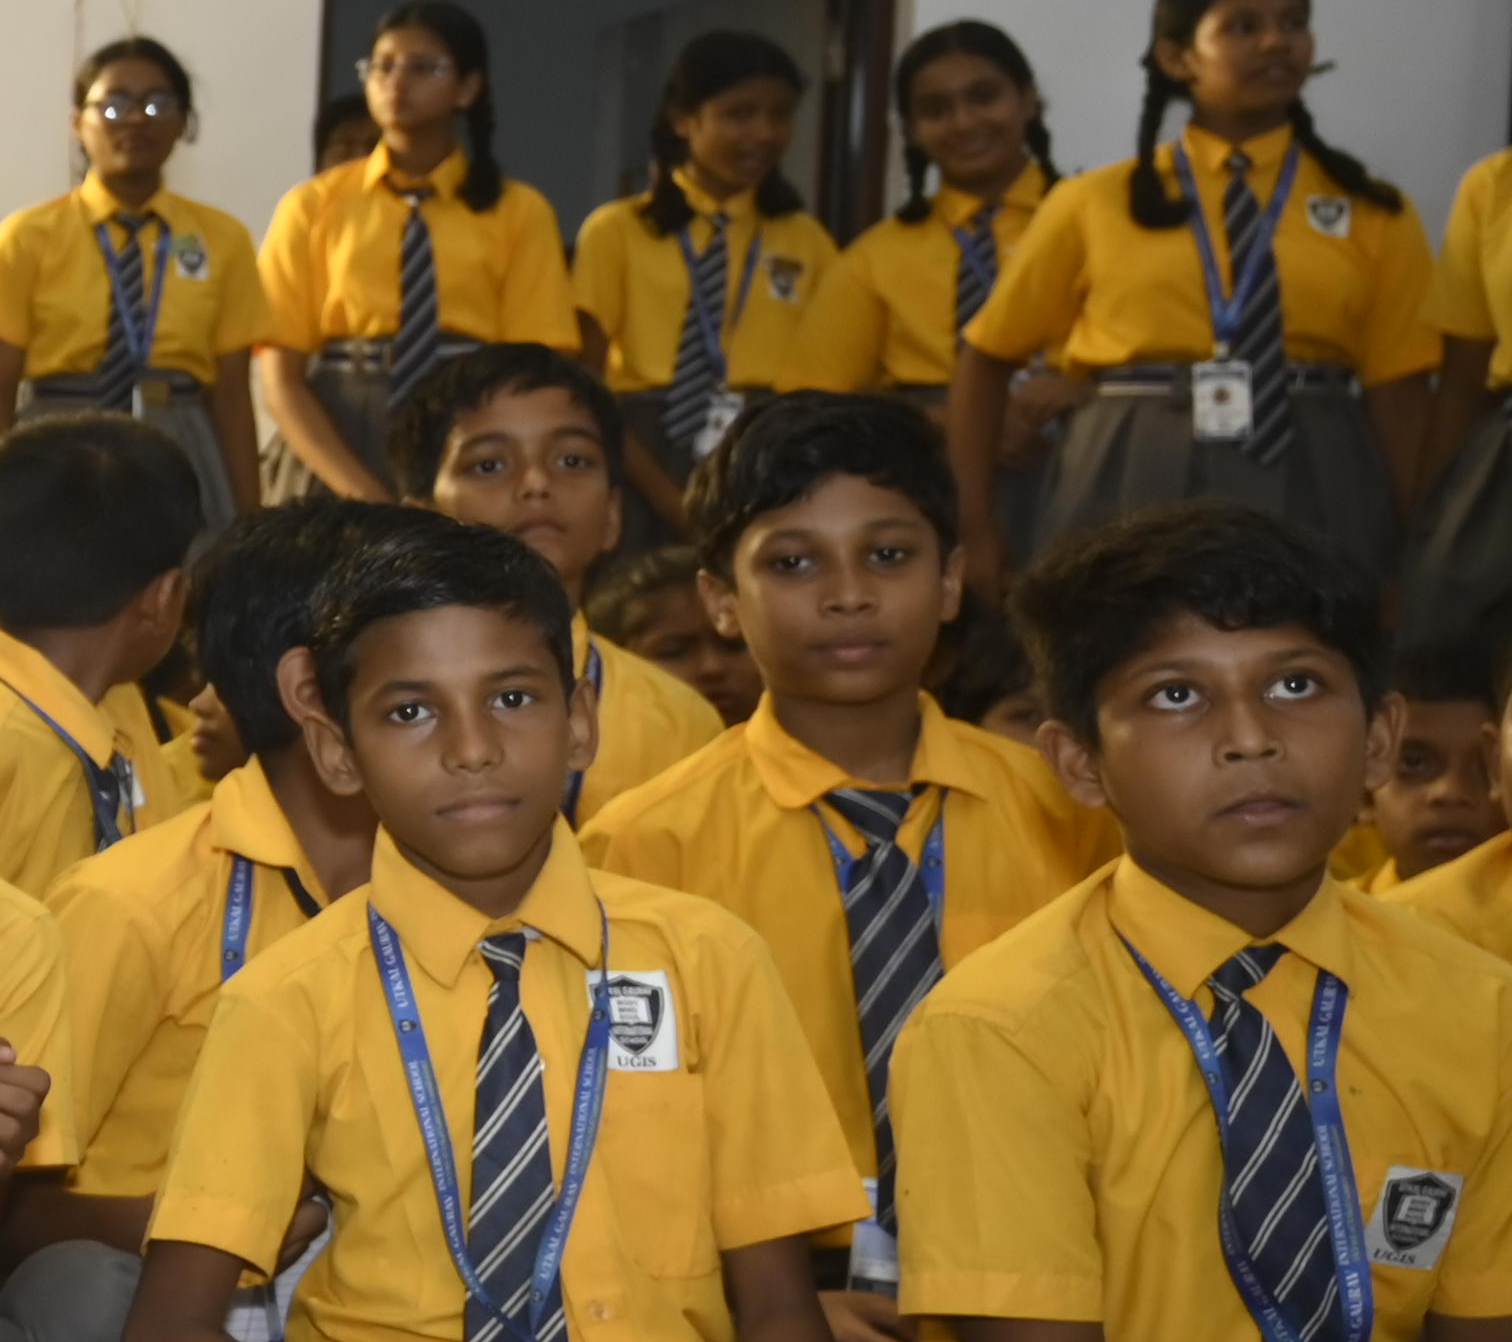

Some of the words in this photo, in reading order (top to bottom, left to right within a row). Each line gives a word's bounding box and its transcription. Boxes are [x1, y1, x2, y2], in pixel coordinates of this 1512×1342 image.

[387, 968, 409, 1008] UTKAL
[616, 1055, 657, 1068] UGIS
[417, 1107, 447, 1192] INTERNATIONAL
[538, 1237, 561, 1280] UTKAL
